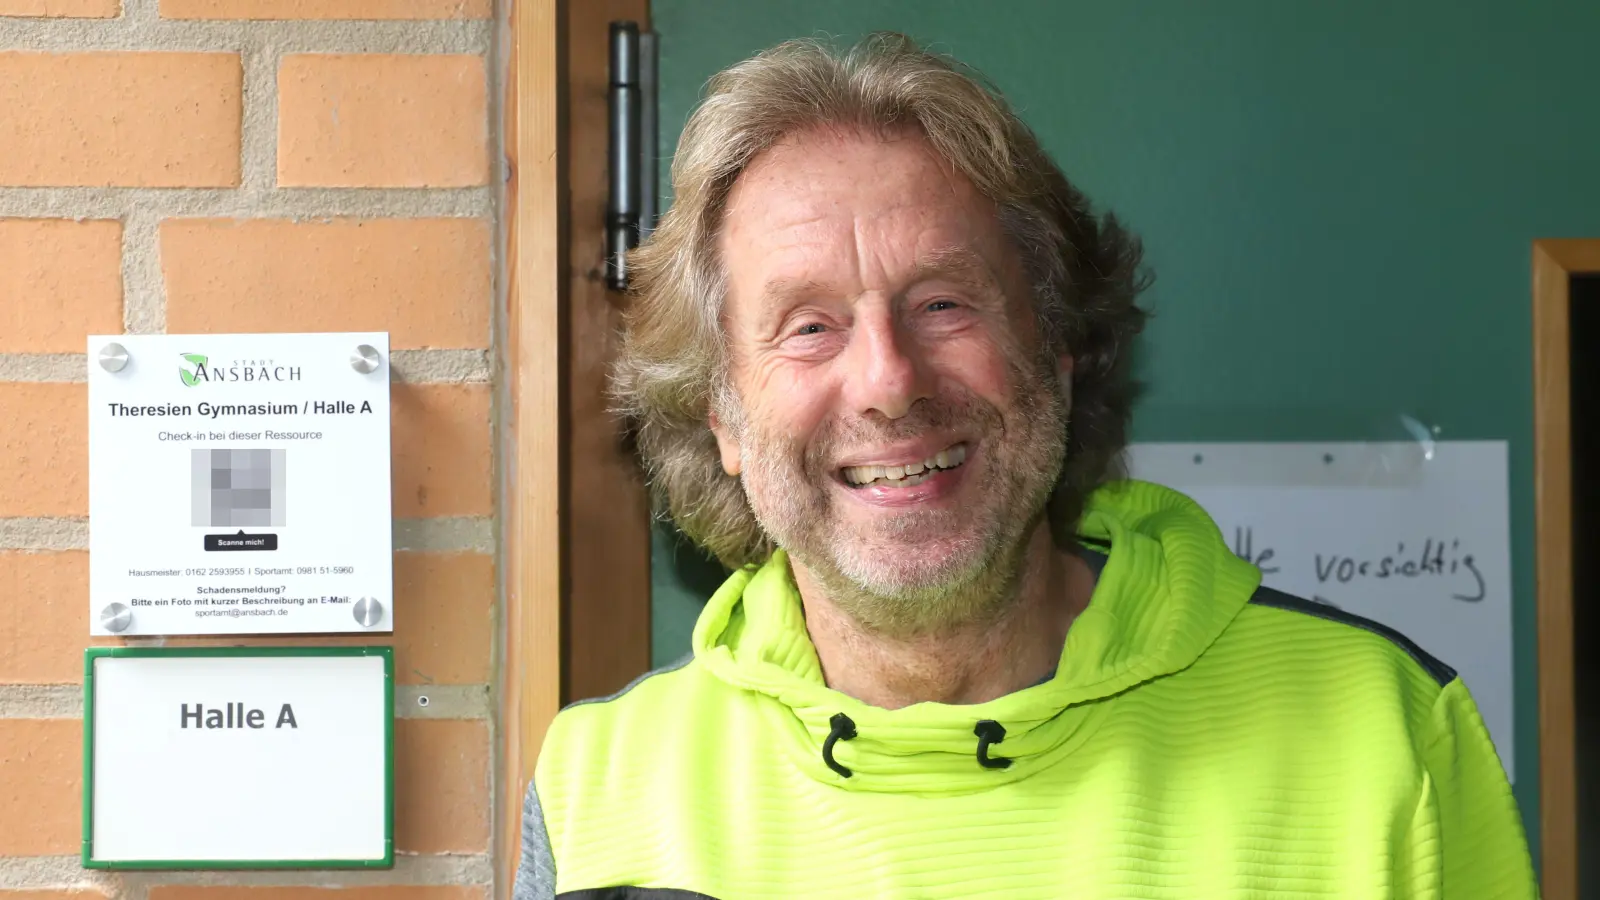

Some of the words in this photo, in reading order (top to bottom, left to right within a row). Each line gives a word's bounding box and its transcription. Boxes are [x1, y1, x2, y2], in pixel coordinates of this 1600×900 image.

[193, 362, 302, 383] ANSBACH
[108, 402, 192, 417] Theresien
[197, 401, 298, 420] Gymnasium
[303, 401, 309, 415] /
[313, 401, 355, 415] Halle
[360, 400, 373, 414] A
[158, 431, 206, 442] Check-in
[209, 430, 226, 441] bei
[229, 430, 262, 441] dieser
[265, 429, 323, 441] Ressource
[217, 538, 244, 546] Scanne
[245, 538, 265, 546] mich!
[128, 568, 183, 577] Hausmeister:
[185, 568, 207, 576] 0162
[208, 567, 245, 576] 2593955
[254, 567, 294, 577] Sportamt:
[296, 566, 317, 575] 0981
[319, 566, 354, 575] 51-5960
[1314, 538, 1487, 603] vorsichtig
[196, 585, 286, 595] Schadensmeldung?
[131, 598, 153, 607] Bitte
[154, 598, 169, 606] ein
[171, 598, 192, 606] Foto
[193, 598, 209, 606] mit
[211, 597, 240, 606] kurzer
[242, 597, 305, 607] Beschreibung
[320, 596, 352, 605] E-Mail:
[195, 607, 289, 618] sportamt@ansbach.de
[180, 702, 265, 729] Halle
[275, 703, 298, 729] A
